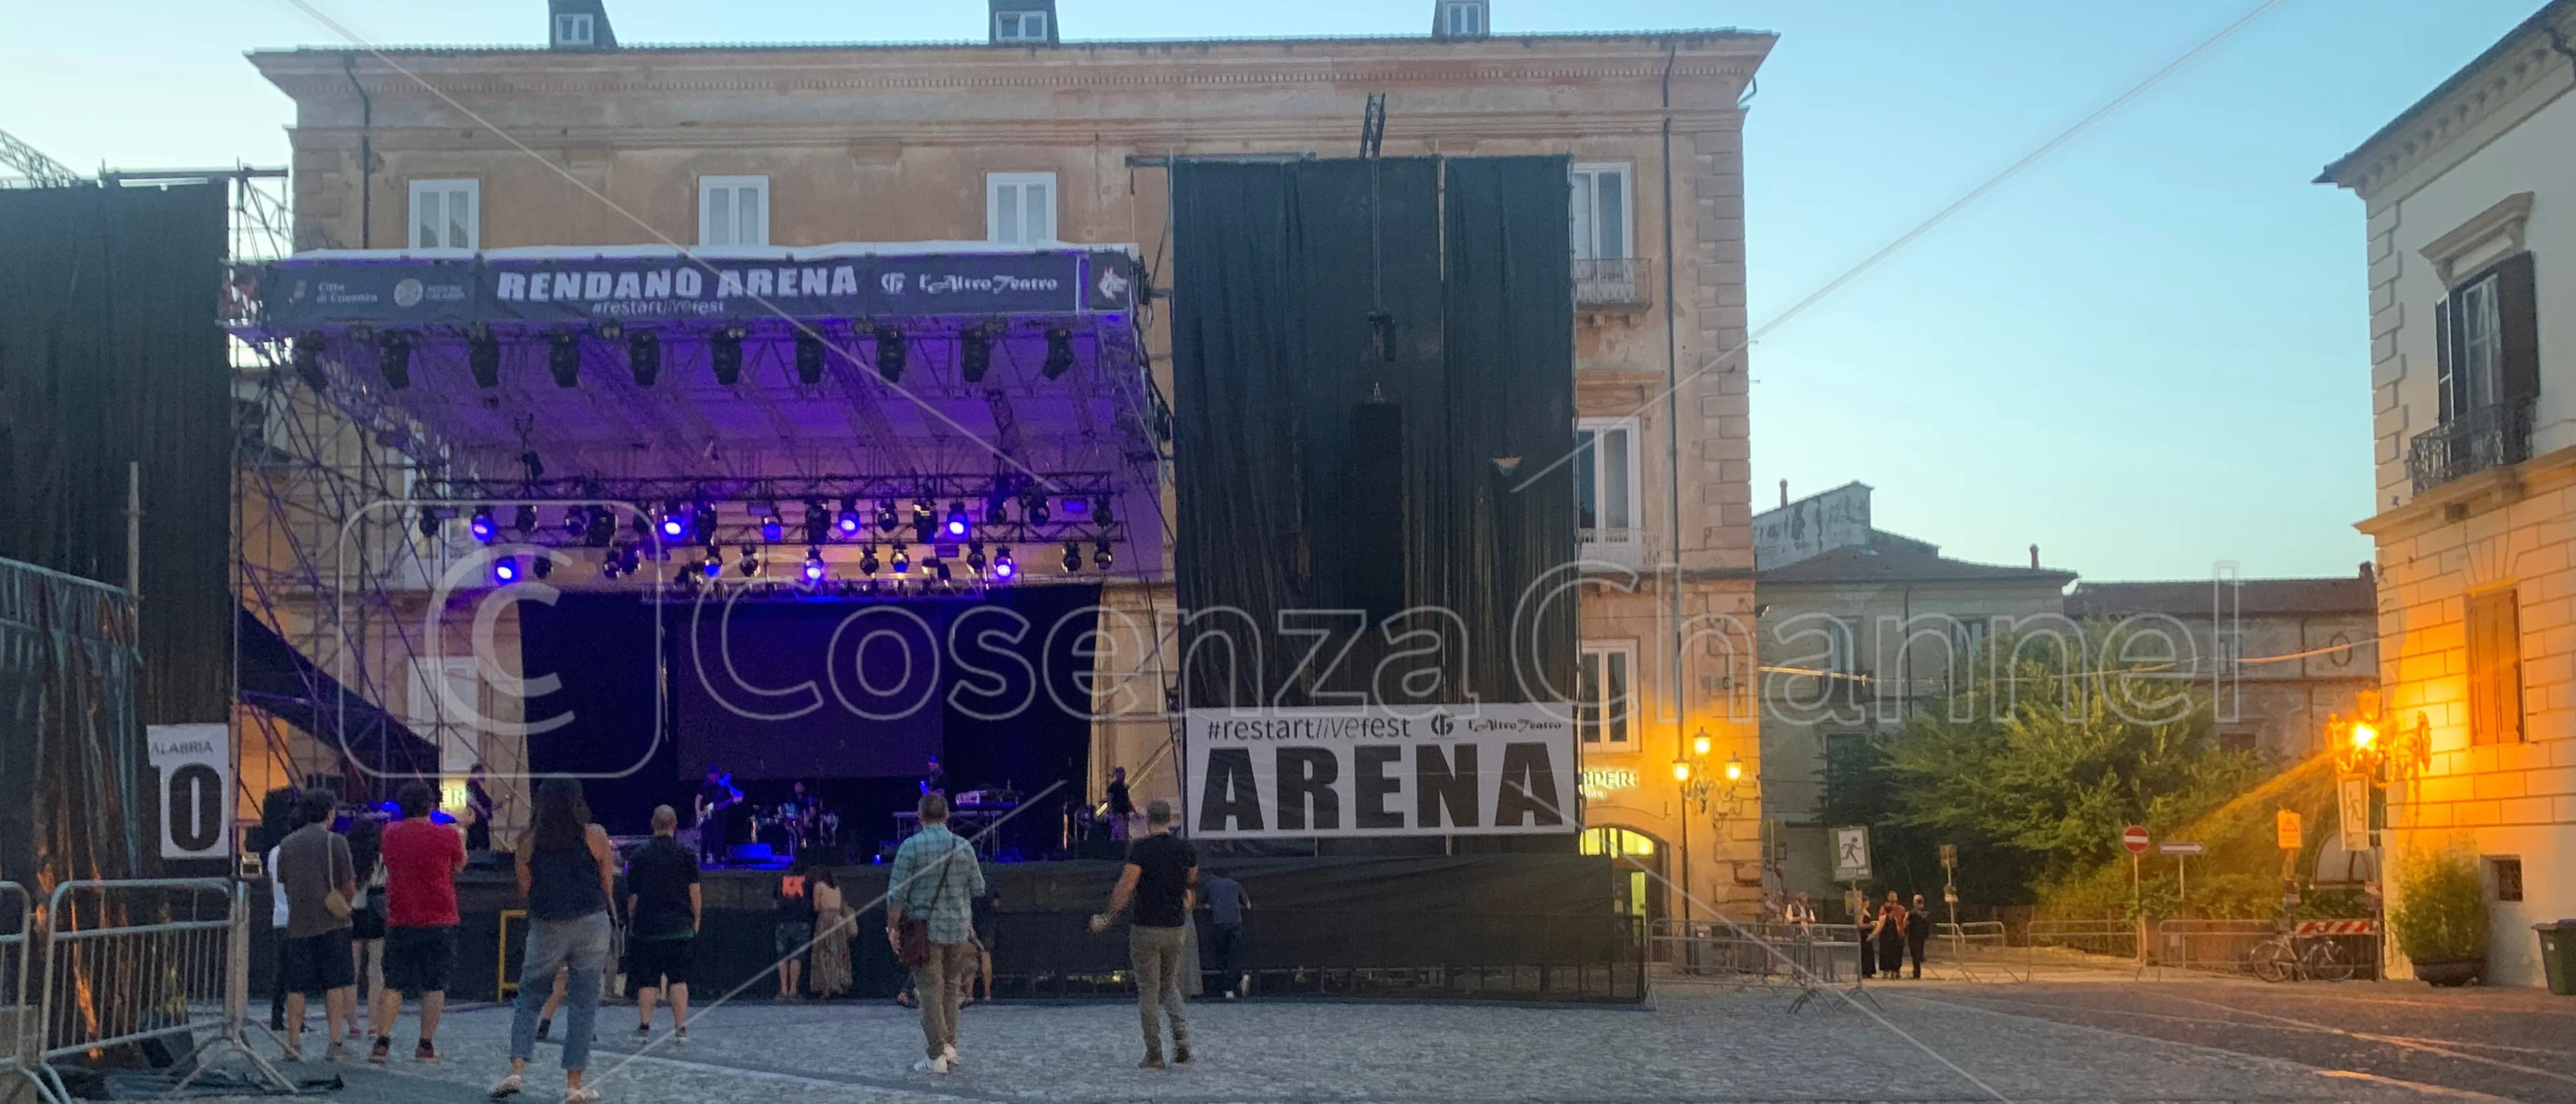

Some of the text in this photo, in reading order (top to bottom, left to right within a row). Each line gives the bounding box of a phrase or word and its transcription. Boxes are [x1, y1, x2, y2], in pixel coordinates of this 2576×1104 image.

[496, 266, 702, 301] RENDANO
[716, 265, 857, 297] ARENA
[1198, 742, 1564, 832] ARENA
